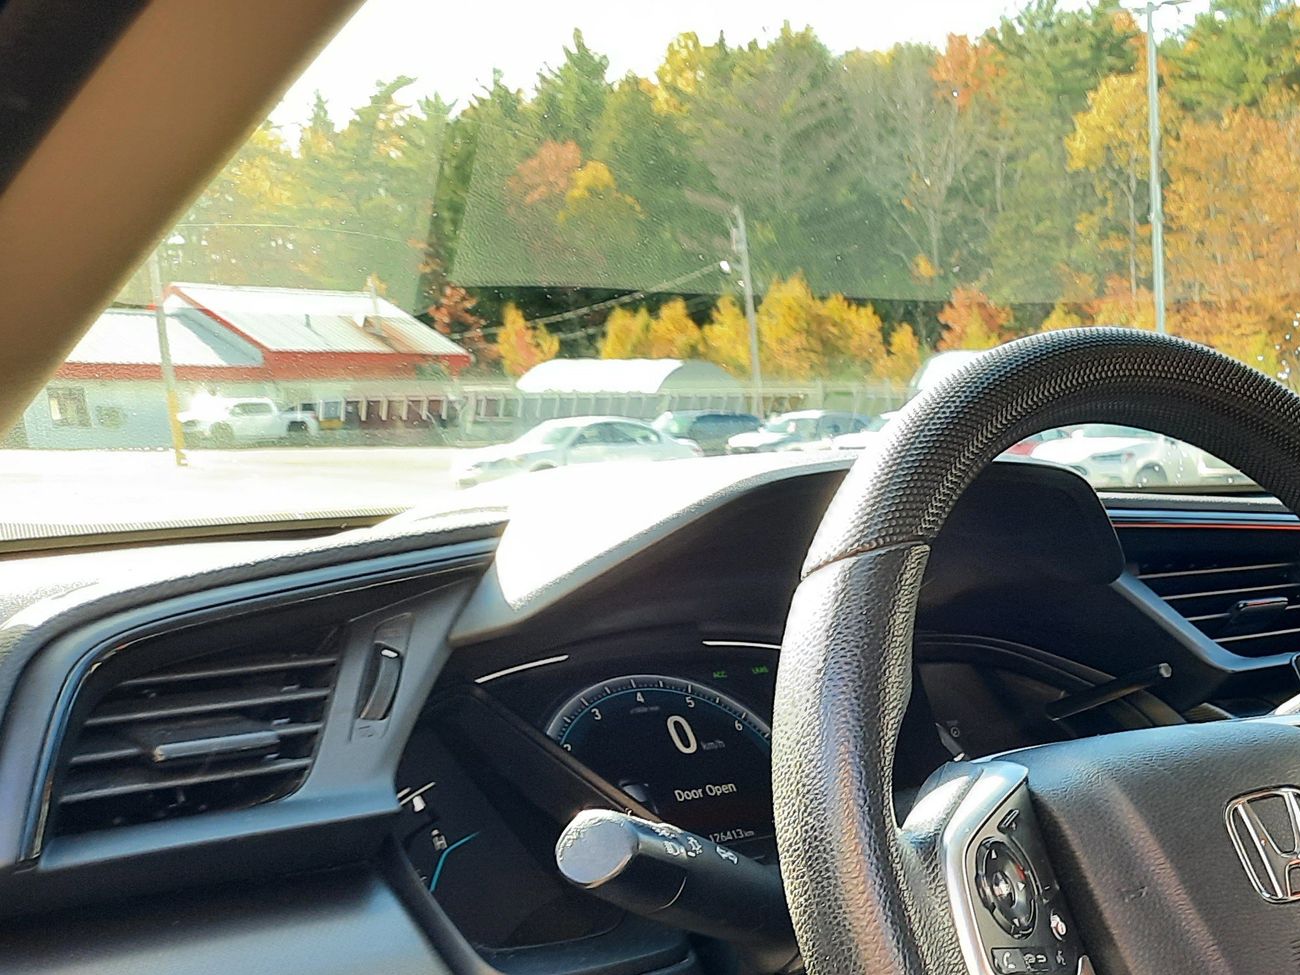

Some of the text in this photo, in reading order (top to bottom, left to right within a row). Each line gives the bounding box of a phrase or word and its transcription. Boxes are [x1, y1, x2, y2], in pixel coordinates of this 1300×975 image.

[590, 707, 602, 720] 3
[635, 691, 645, 703] 4
[686, 696, 695, 708] 5
[734, 719, 744, 731] 6
[666, 714, 698, 755] 0
[674, 783, 737, 802] Door Open
